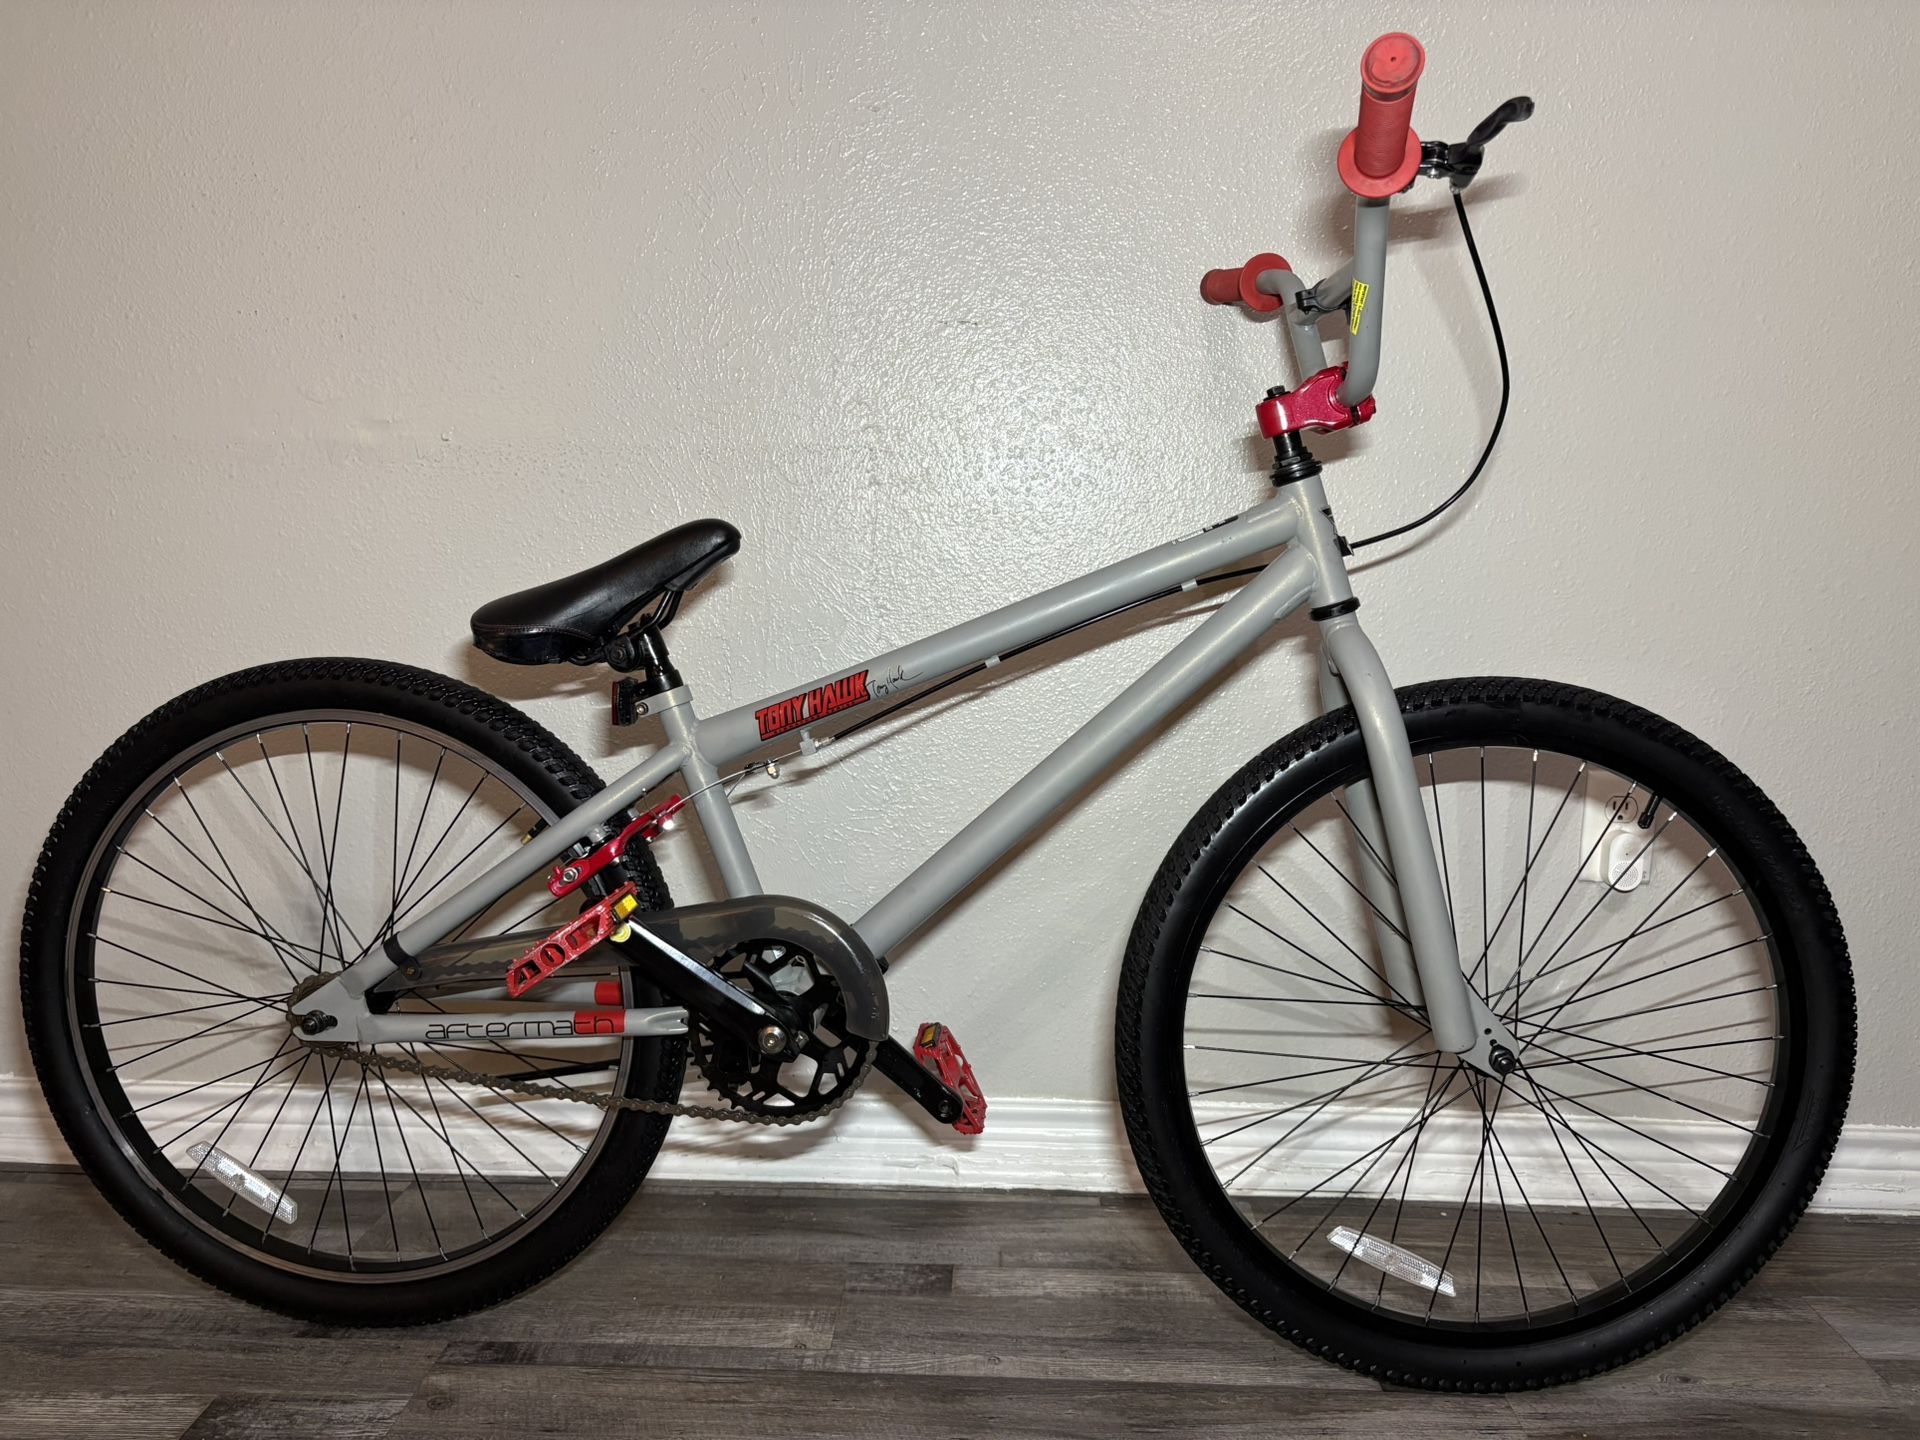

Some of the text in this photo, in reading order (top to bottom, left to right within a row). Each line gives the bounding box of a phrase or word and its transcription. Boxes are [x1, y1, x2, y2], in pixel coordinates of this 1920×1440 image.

[755, 669, 870, 736] TONY HAWK
[425, 1015, 615, 1040] aftermath
